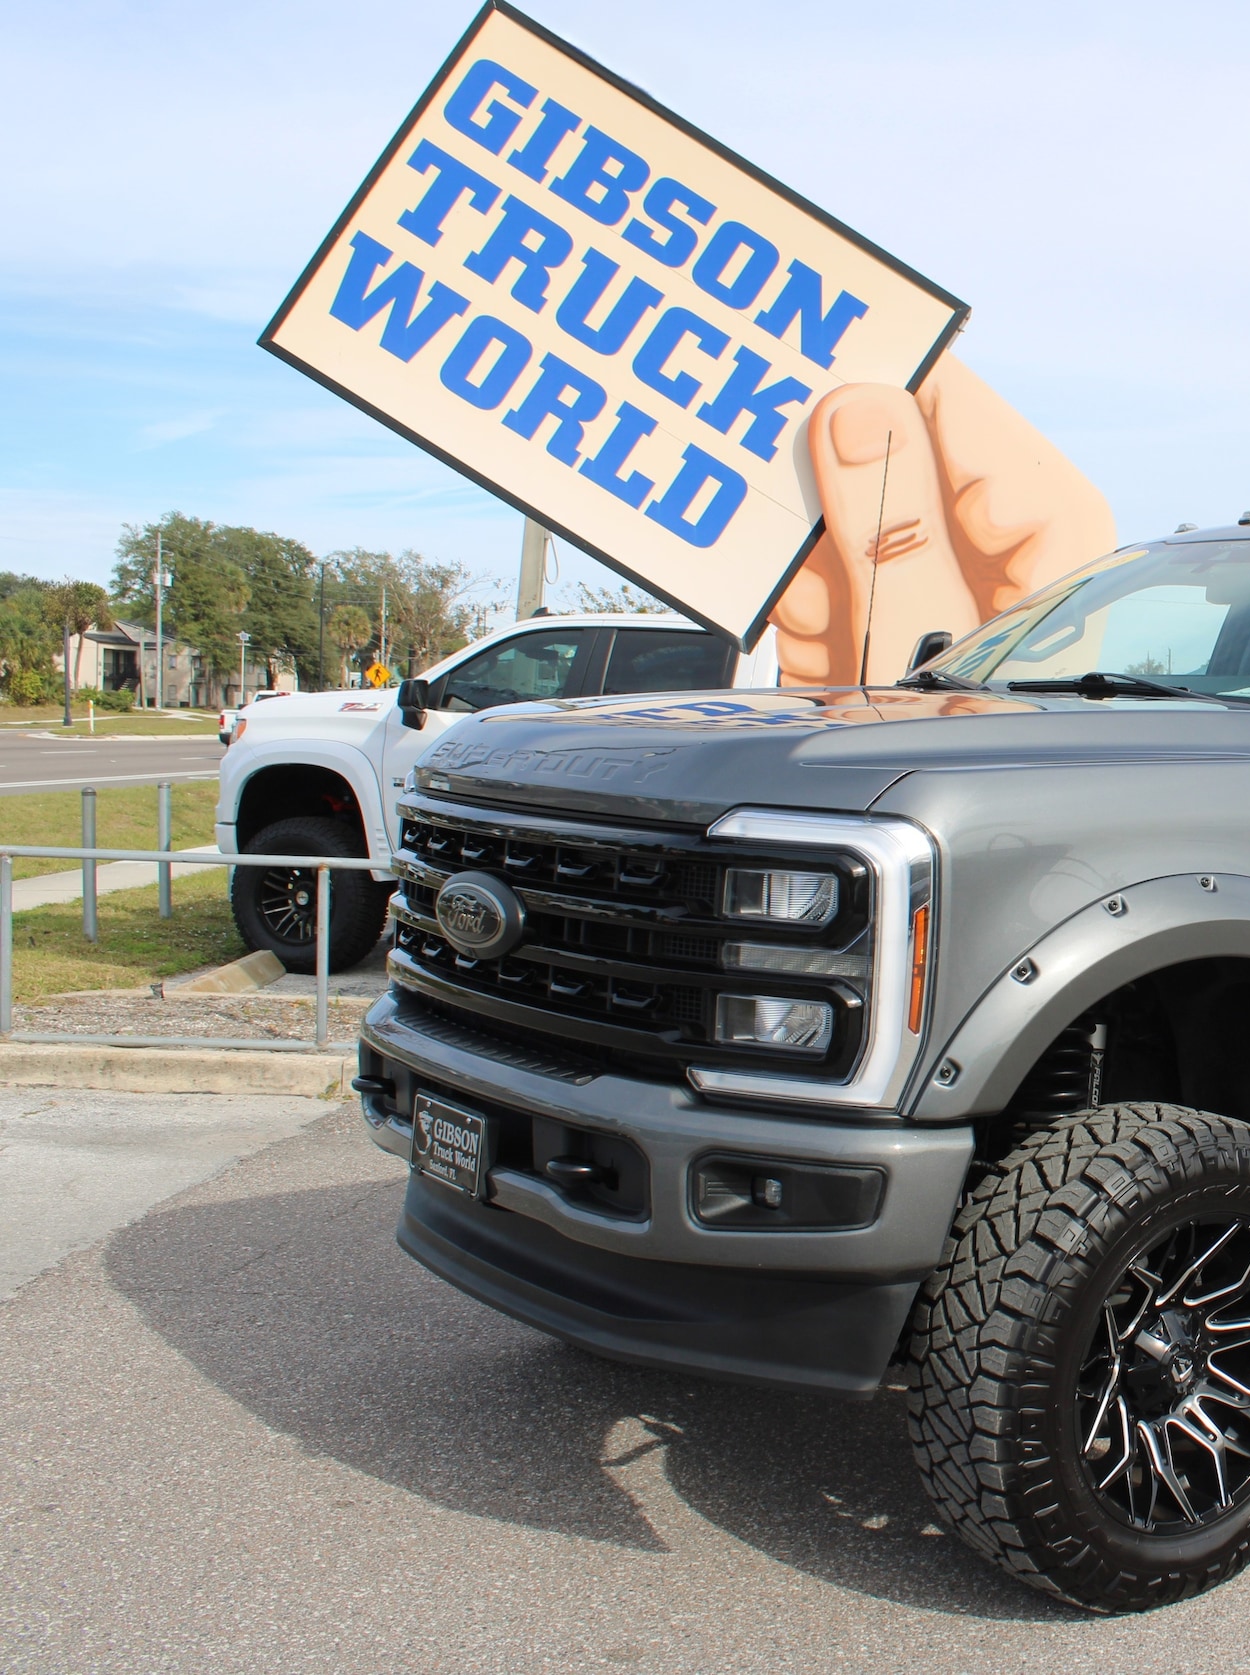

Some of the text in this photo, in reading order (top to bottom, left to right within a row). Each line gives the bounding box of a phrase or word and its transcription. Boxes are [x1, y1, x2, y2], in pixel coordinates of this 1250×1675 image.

[443, 59, 870, 371] GIBSON
[397, 138, 814, 463] TRUCK
[329, 229, 749, 549] WORLD
[533, 754, 671, 784] DUTY
[447, 894, 486, 934] Ford
[433, 1141, 476, 1172] Truck World
[434, 1118, 479, 1155] GIBSON
